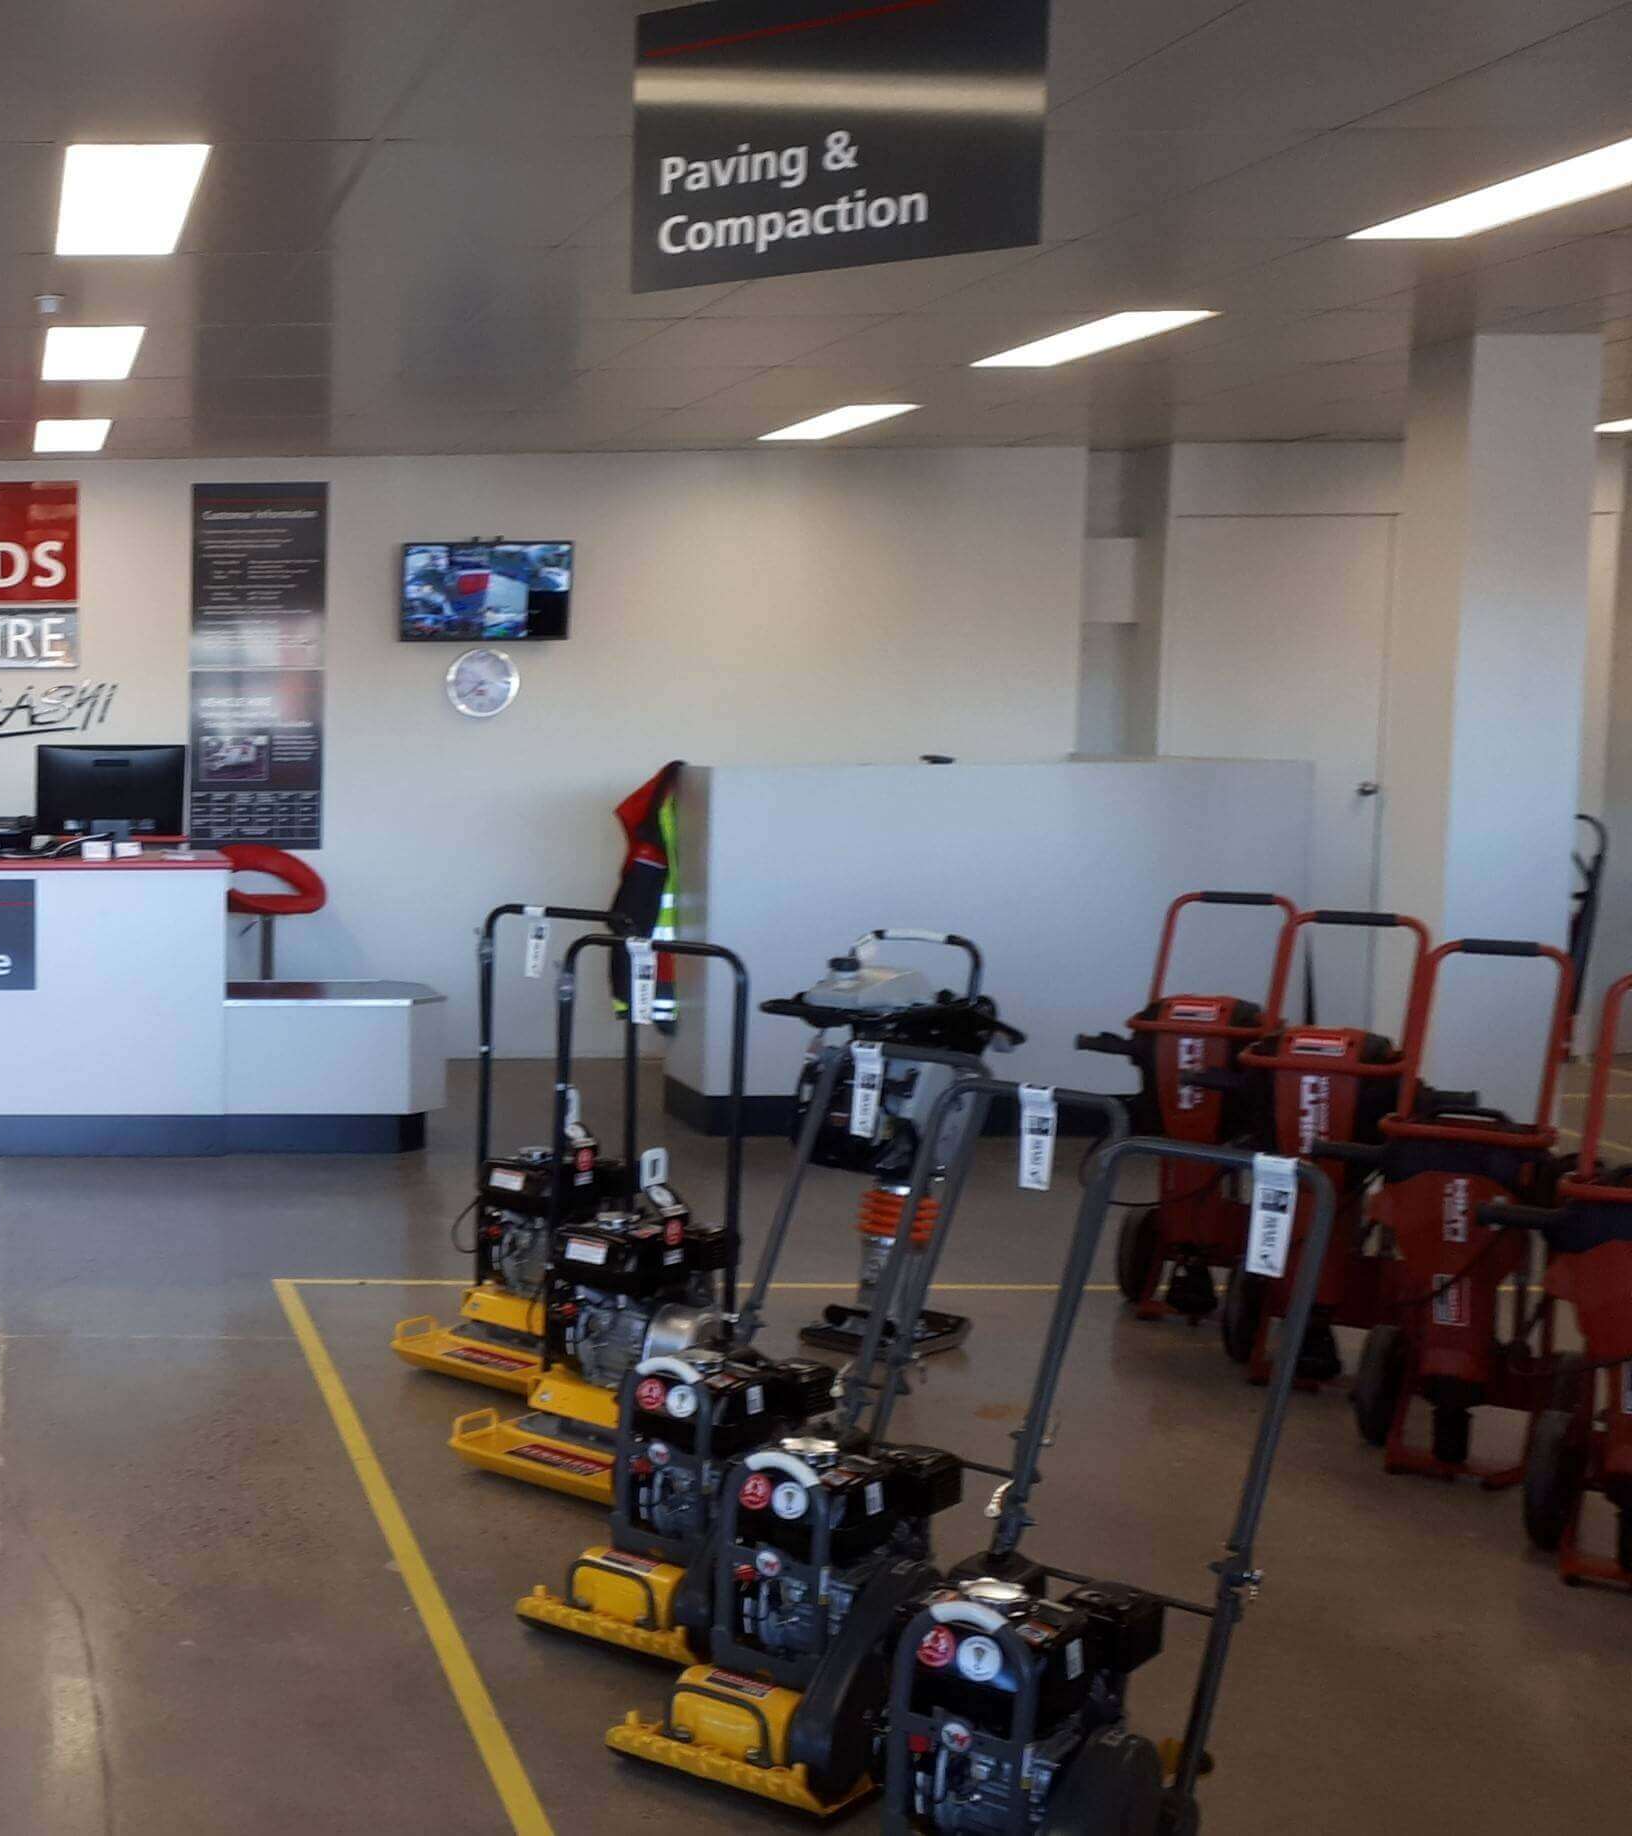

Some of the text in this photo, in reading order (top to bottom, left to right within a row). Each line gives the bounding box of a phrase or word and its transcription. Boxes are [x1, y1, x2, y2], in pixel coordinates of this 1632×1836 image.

[659, 130, 859, 195] Paving &
[657, 188, 929, 255] Compaction
